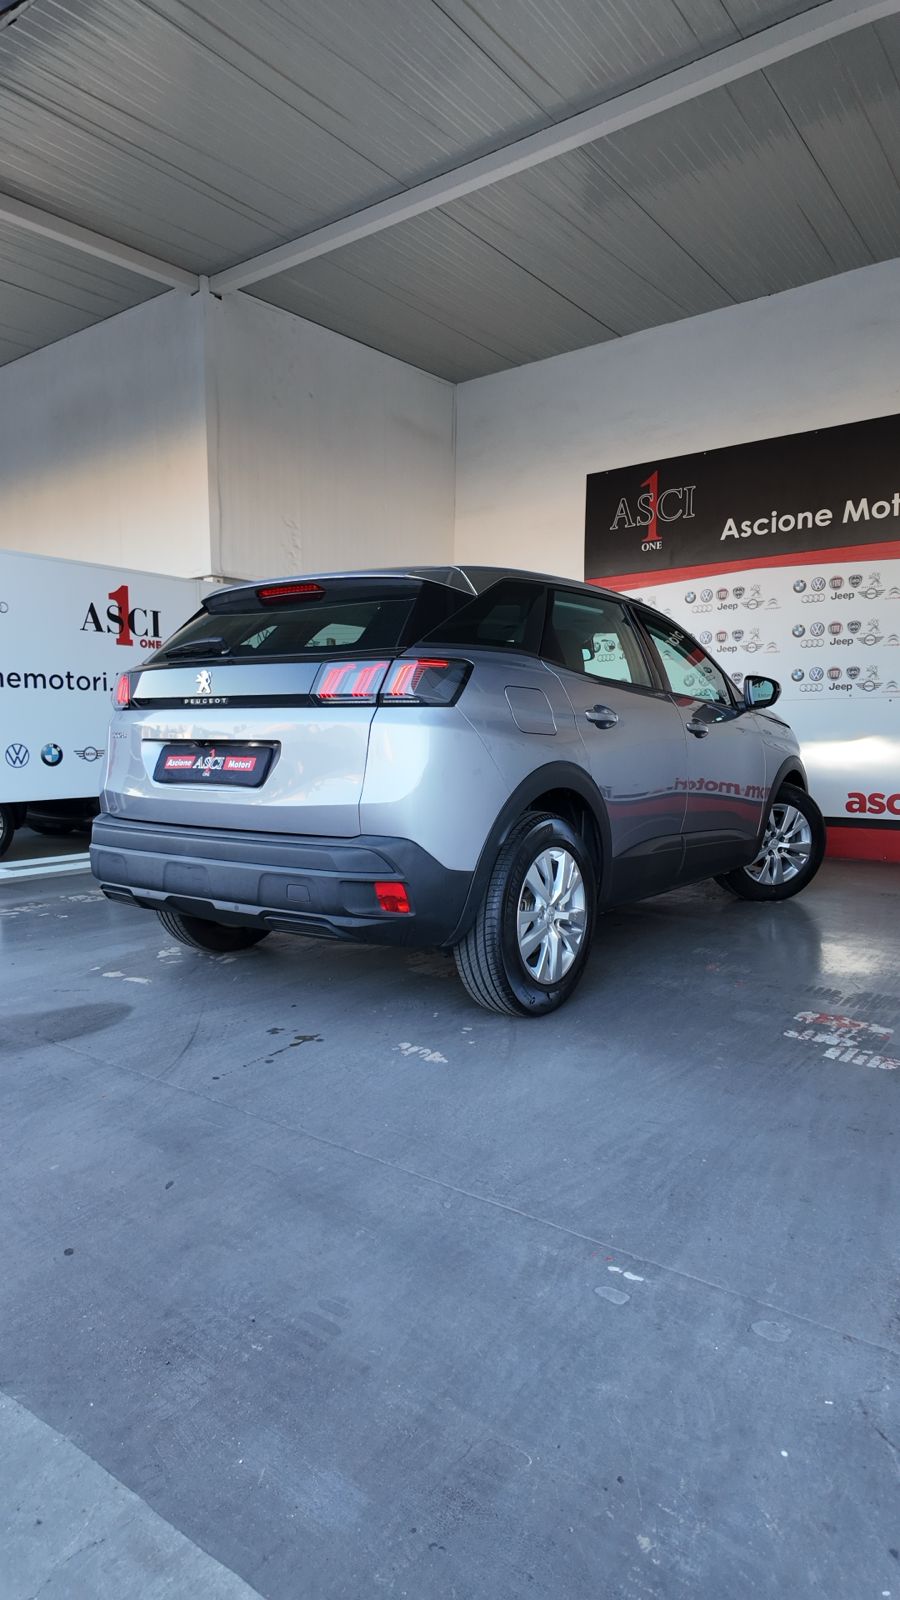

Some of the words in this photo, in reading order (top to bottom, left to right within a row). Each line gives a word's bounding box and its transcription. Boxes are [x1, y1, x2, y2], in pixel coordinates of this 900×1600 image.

[609, 485, 697, 531] ASCI
[720, 508, 834, 541] Ascione
[842, 492, 900, 524] Mot
[641, 541, 663, 552] ONE
[831, 592, 855, 601] Jeep
[716, 603, 738, 611] Jeep
[80, 601, 162, 639] ASCI
[140, 639, 162, 650] ONE
[829, 637, 854, 646] Jeep
[716, 645, 738, 654] Jeep
[0, 671, 119, 692] emotori.
[828, 682, 853, 692] Jeep
[184, 697, 228, 705] PEUGEOT
[227, 760, 253, 769] Motori
[845, 792, 900, 816] asc
